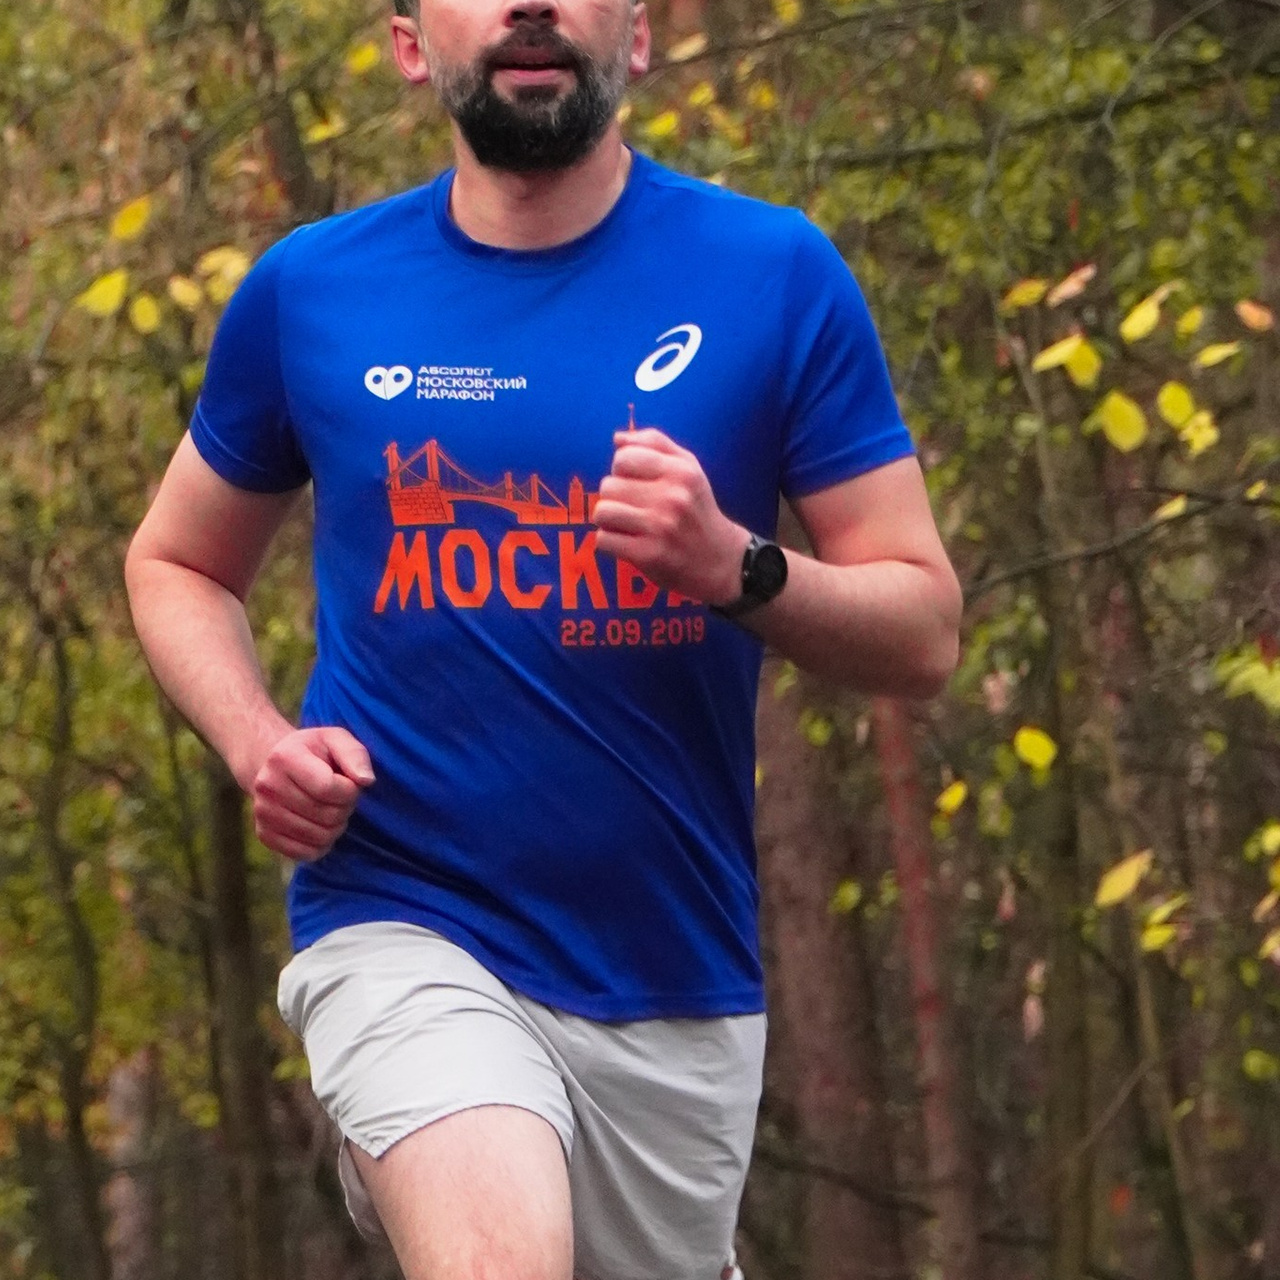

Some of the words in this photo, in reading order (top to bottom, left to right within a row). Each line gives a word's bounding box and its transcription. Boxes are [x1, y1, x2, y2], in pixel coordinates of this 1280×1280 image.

[418, 366, 494, 377] АБСОЛЮТ
[416, 374, 527, 390] МОСКОВСКИЙ
[416, 388, 495, 402] МАРАФОН
[374, 528, 703, 614] МОСКВ
[561, 616, 705, 647] 22.09.2019
